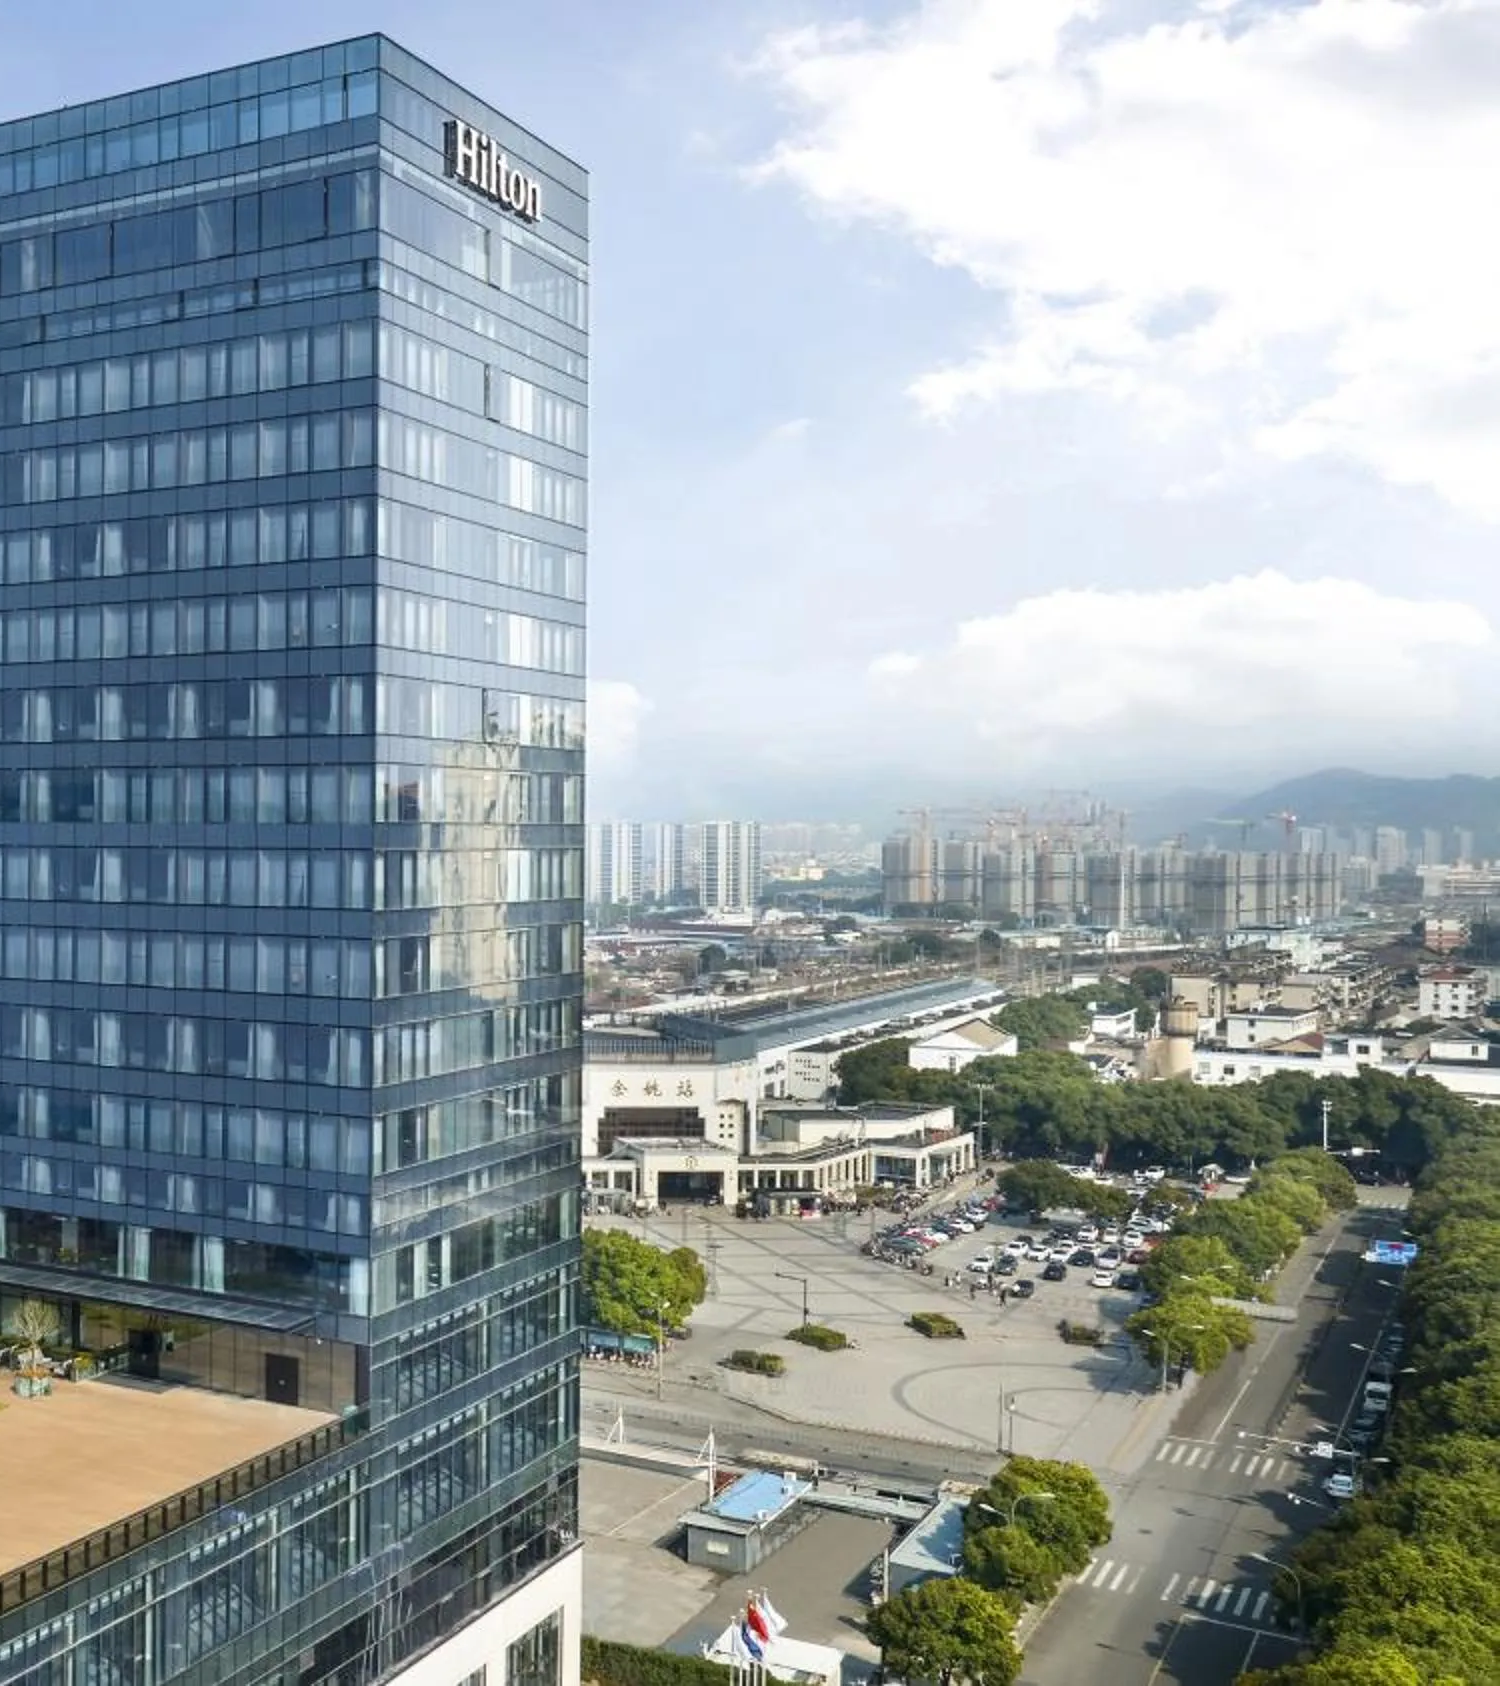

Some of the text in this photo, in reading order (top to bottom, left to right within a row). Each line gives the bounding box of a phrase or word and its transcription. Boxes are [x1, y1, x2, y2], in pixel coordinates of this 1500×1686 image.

[453, 120, 542, 223] Hilton
[611, 1079, 693, 1098] 余姚站
